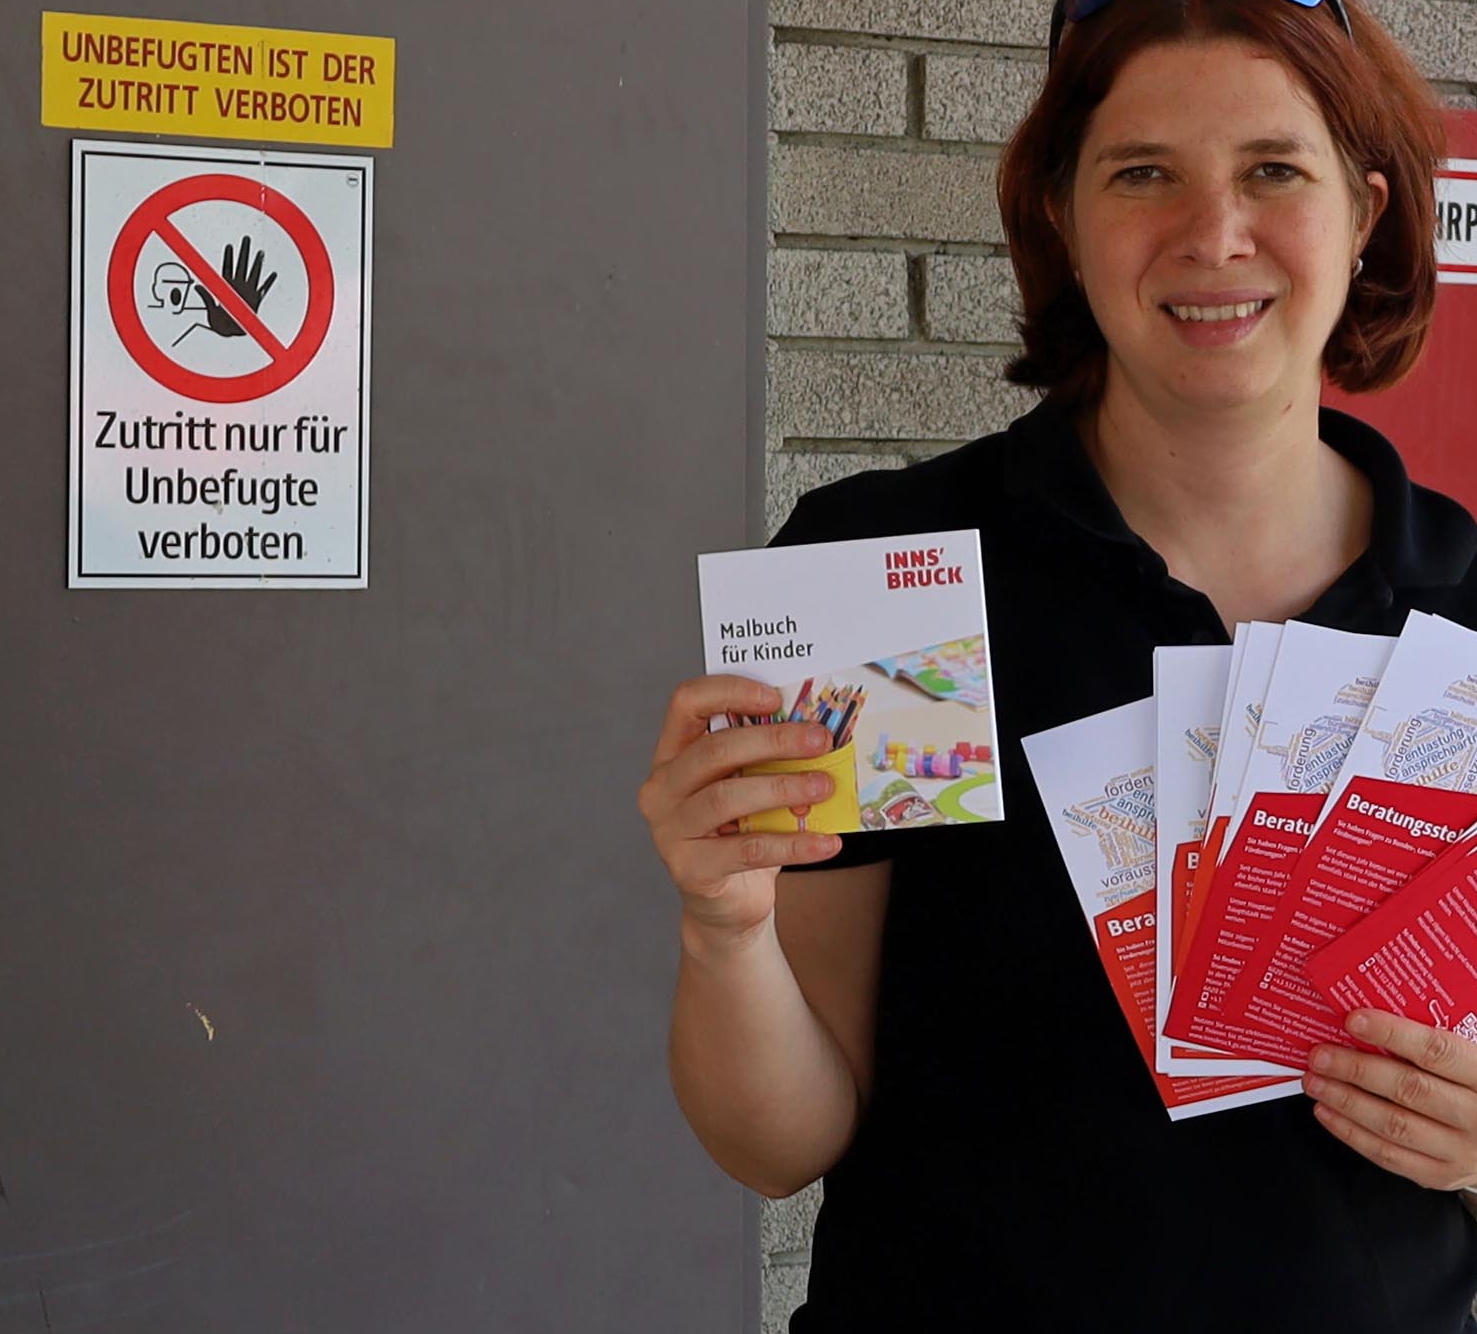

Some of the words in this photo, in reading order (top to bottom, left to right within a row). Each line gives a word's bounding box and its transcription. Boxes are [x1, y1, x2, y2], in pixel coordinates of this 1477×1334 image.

[62, 30, 254, 77] UNBEFUGTEN
[268, 47, 309, 80] IST
[323, 53, 376, 86] DER
[78, 77, 199, 116] ZUTRITT
[214, 87, 363, 127] VERBOTEN
[94, 410, 218, 451] Zutritt
[224, 421, 288, 453] nur
[293, 417, 349, 455] für
[124, 467, 320, 515] Unbefugte
[136, 523, 305, 560] verboten
[885, 548, 945, 570] INNS'
[886, 566, 964, 590] BRUCK
[719, 615, 798, 639] Malbuch
[720, 644, 748, 664] für
[753, 640, 815, 661] Kinder
